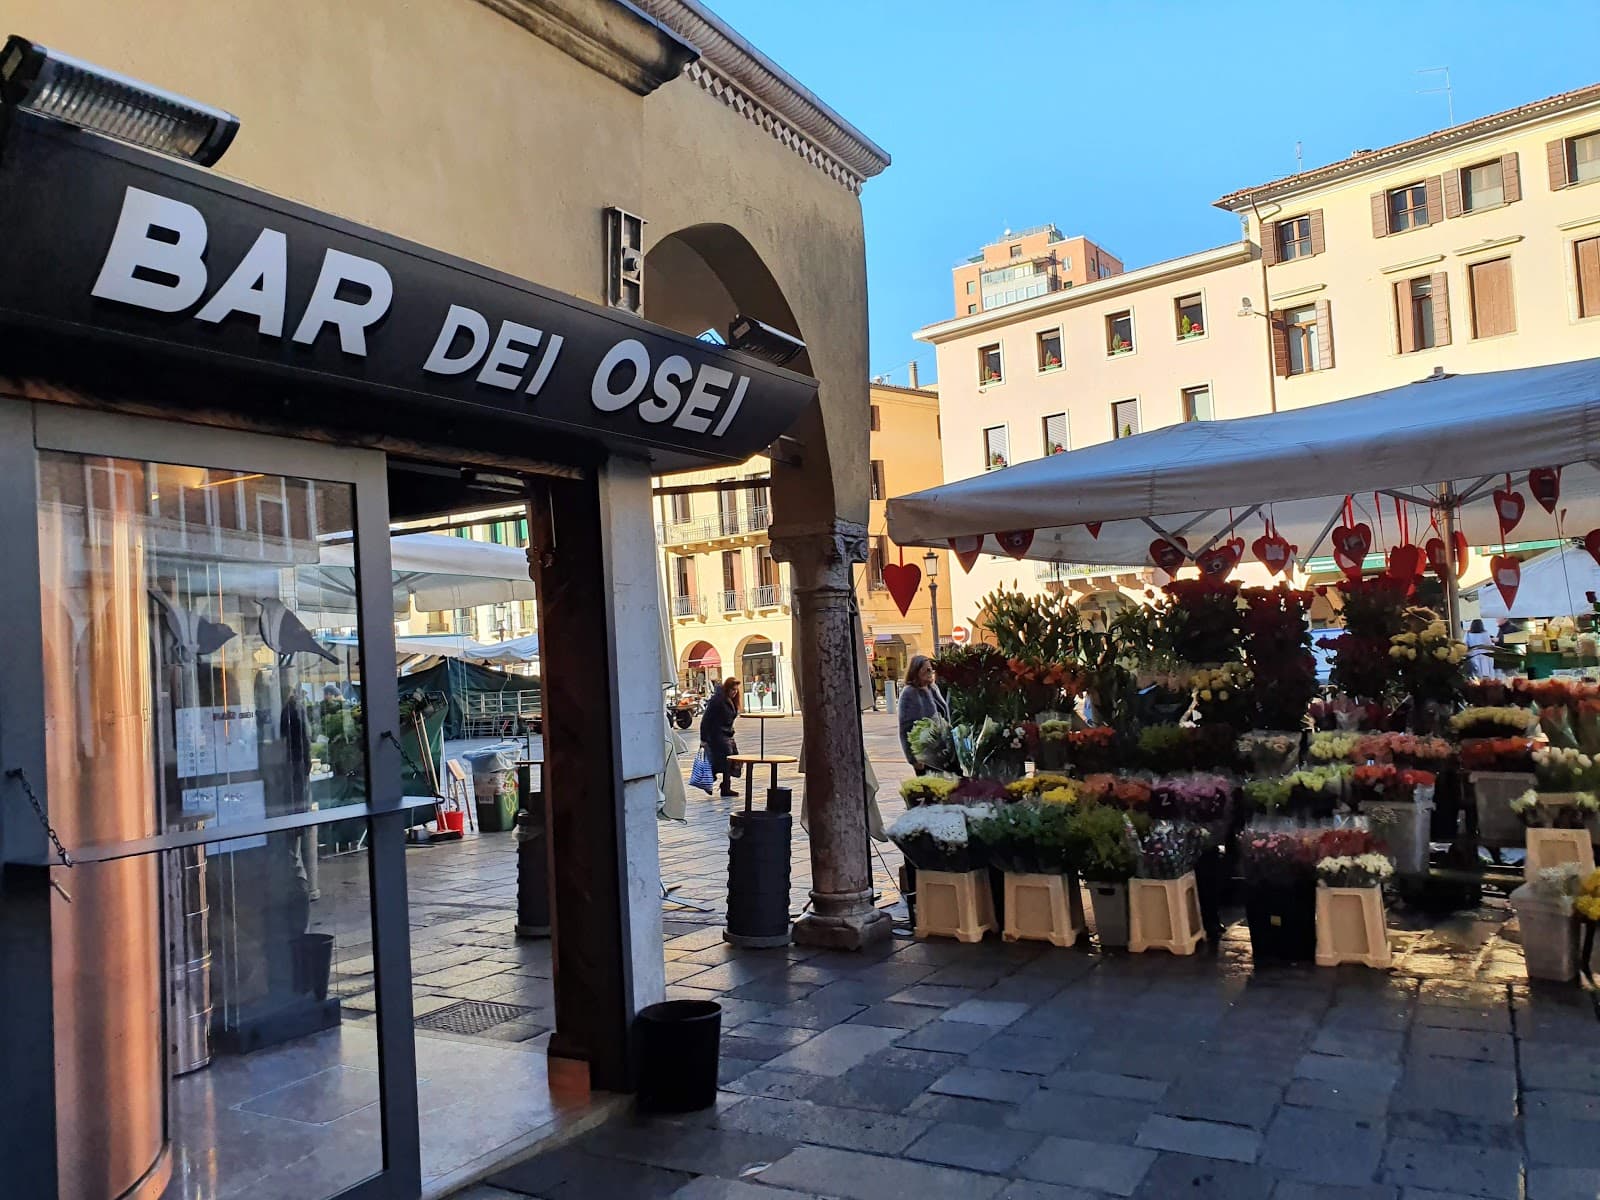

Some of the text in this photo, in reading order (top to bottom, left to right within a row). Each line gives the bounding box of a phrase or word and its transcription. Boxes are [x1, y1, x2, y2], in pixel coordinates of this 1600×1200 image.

[92, 186, 750, 436] BAR DEI OSEI
